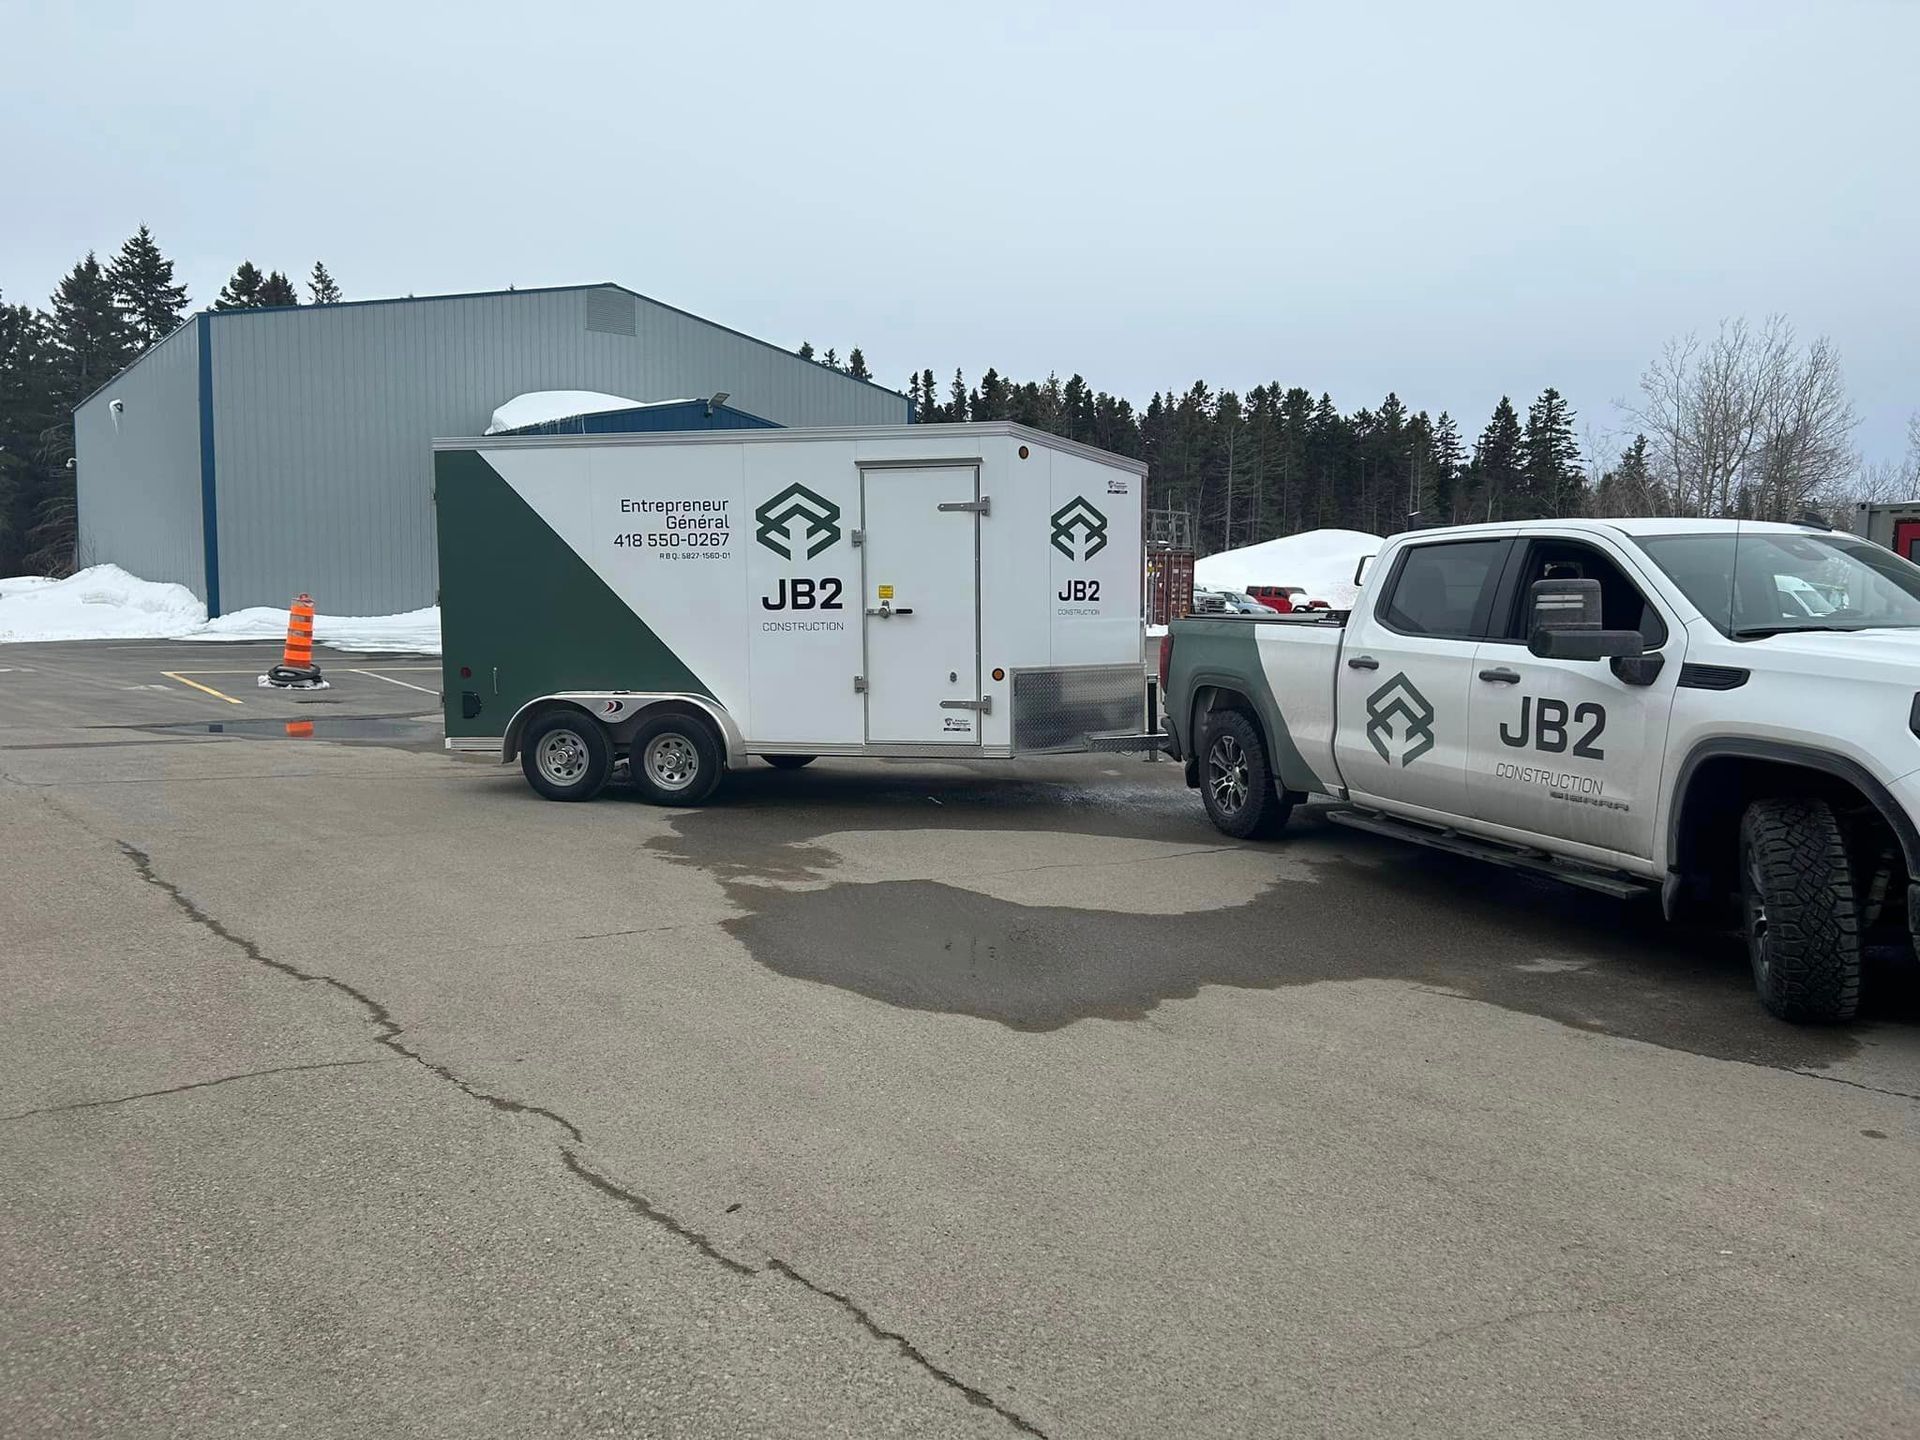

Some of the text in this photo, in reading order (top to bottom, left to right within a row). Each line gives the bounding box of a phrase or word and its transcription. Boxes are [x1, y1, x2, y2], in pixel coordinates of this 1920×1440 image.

[621, 499, 729, 515] Entrepreneur
[666, 514, 730, 529] Général
[613, 532, 730, 547] 418 550-0267
[762, 578, 843, 610] JB2
[1058, 580, 1100, 601] JB2
[1057, 608, 1100, 616] CONSTRUCTION
[762, 621, 844, 632] CONSTRUCTION
[1499, 696, 1606, 760] JB2
[1496, 763, 1603, 795] CONSTRUCTION
